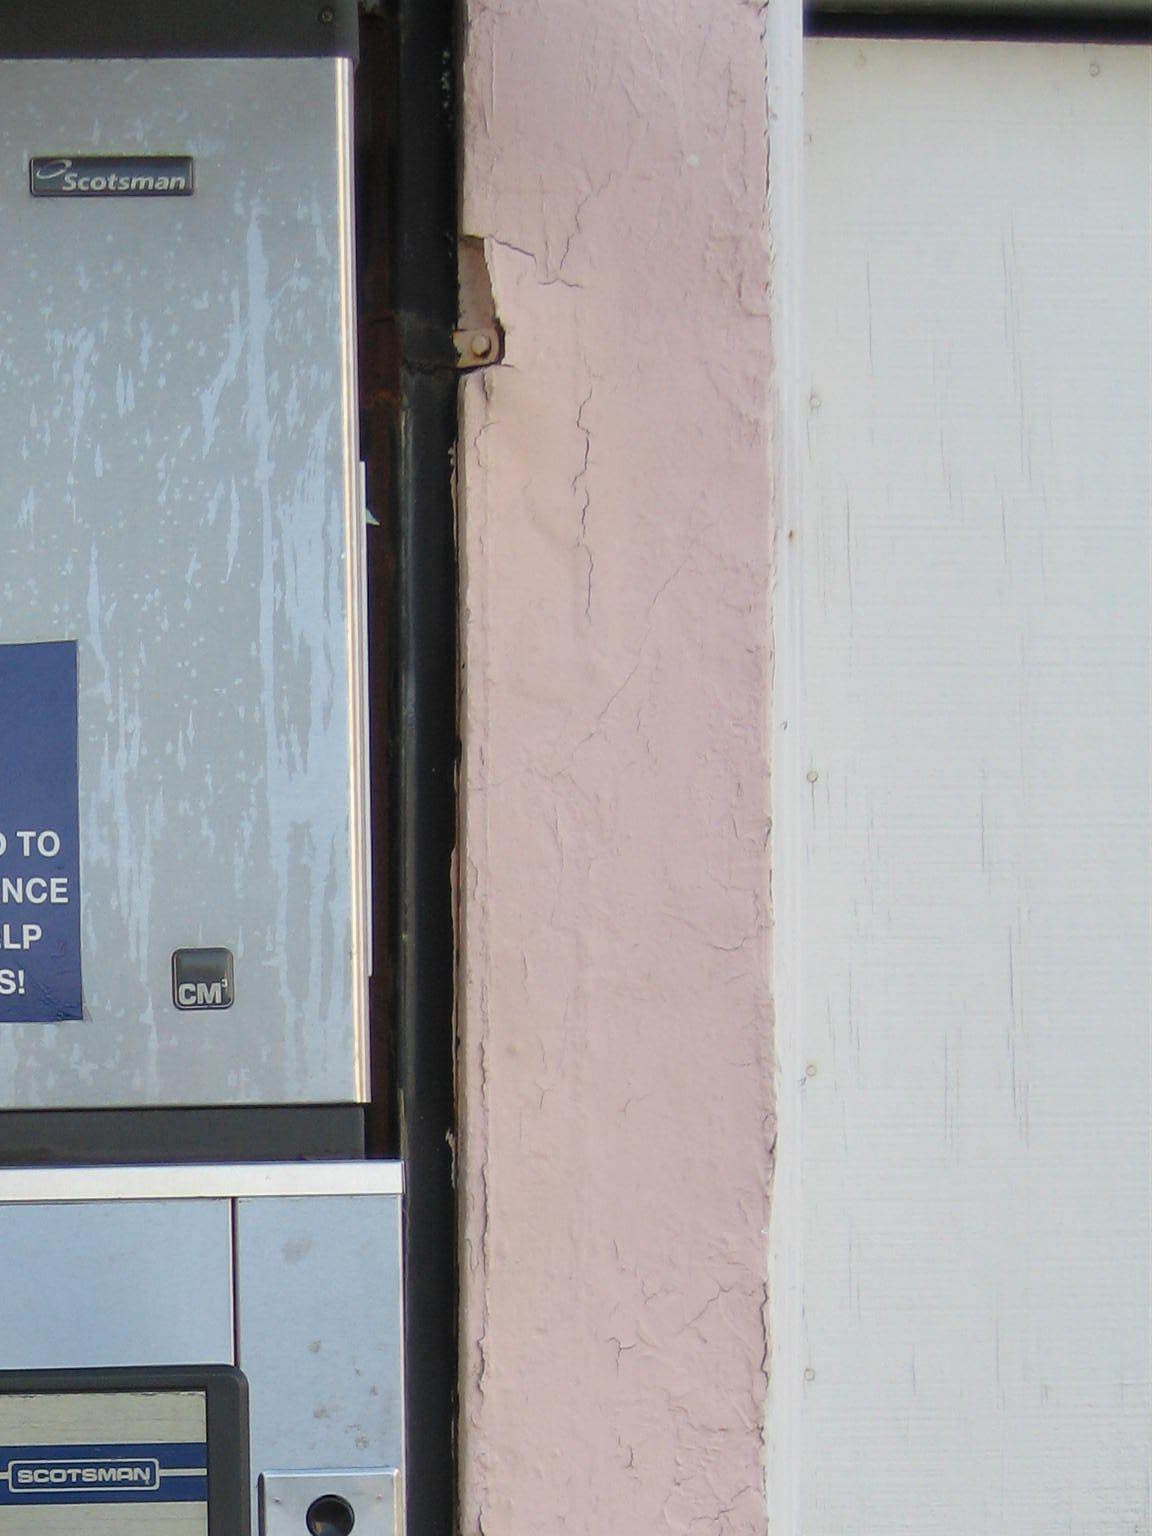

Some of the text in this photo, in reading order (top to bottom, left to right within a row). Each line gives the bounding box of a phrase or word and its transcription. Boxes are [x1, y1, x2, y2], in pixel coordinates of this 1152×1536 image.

[62, 171, 186, 192] Scotsman
[15, 830, 61, 857] TO
[16, 1467, 151, 1484] SCOTSMAN
